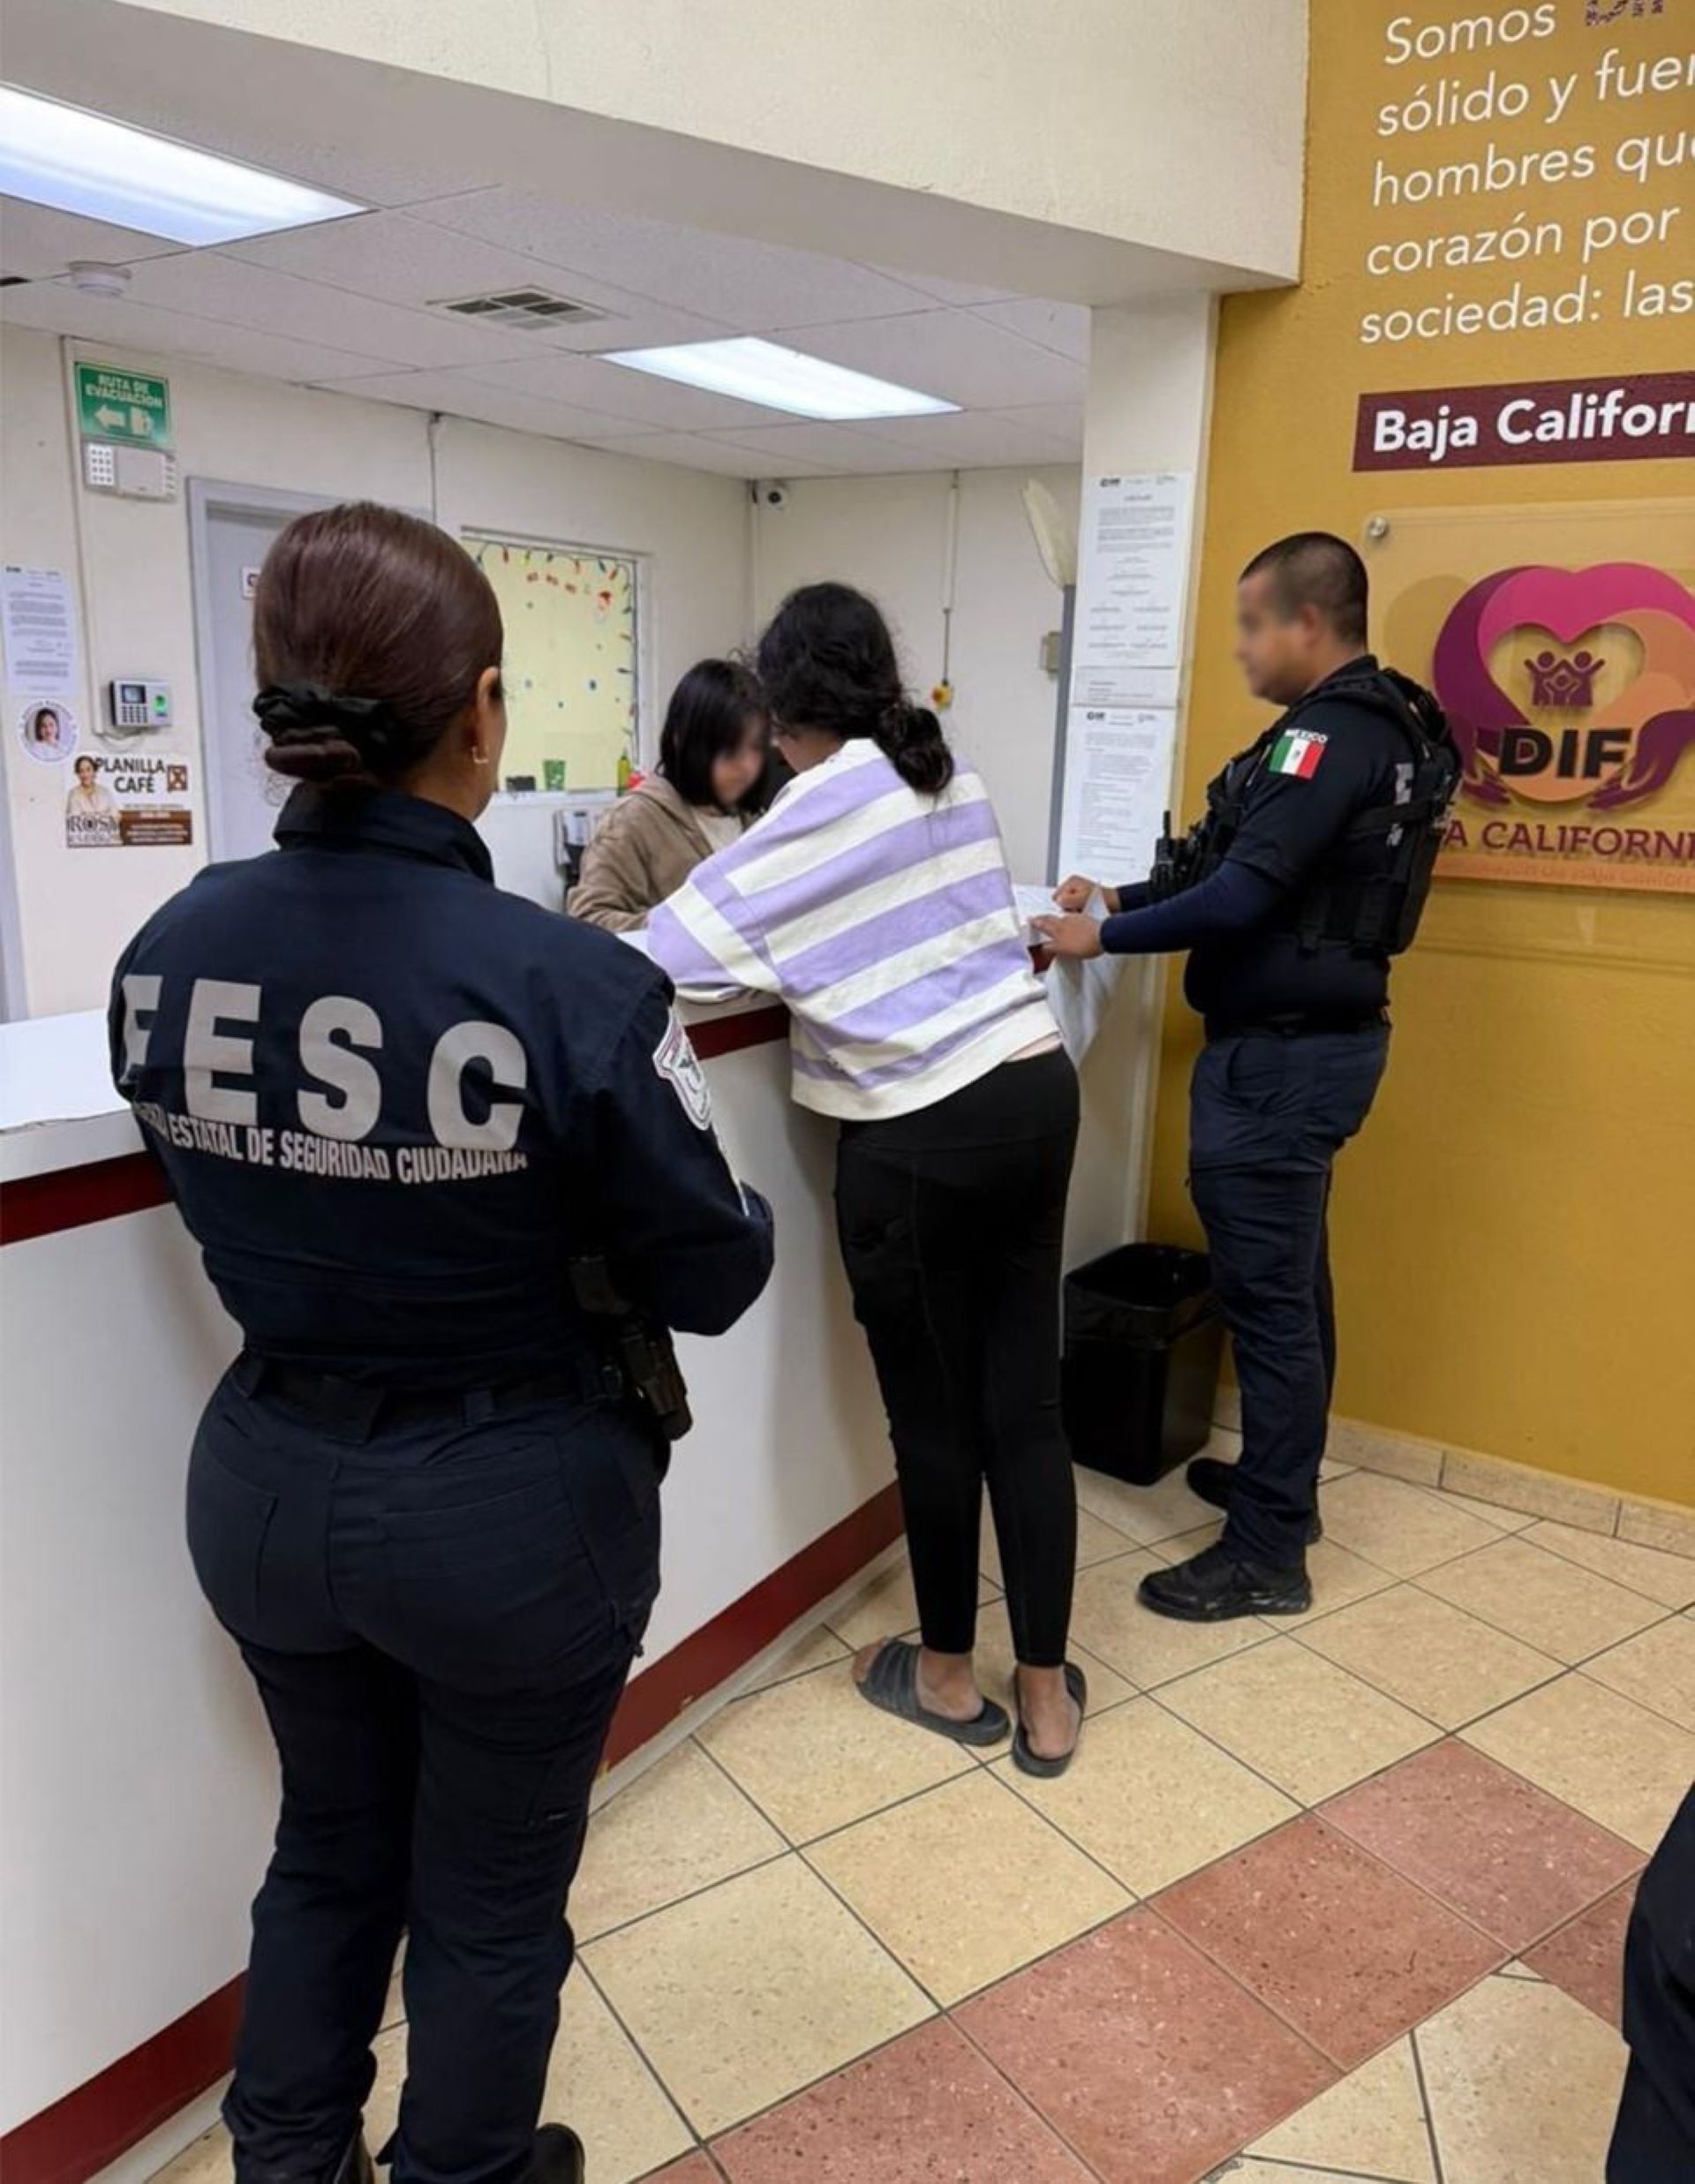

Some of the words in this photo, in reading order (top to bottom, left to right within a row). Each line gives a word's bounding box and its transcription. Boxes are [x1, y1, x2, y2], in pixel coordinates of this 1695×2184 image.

[1384, 4, 1556, 64] Somos
[1377, 70, 1530, 137] sólido
[1544, 73, 1578, 124] y
[1373, 143, 1595, 207] hombres
[1616, 132, 1695, 184] qu
[1367, 211, 1563, 275] corazón
[1582, 206, 1681, 264] por
[1360, 275, 1603, 343] sociedad:
[1623, 268, 1695, 318] las
[1373, 404, 1478, 463] Baja
[94, 757, 165, 774] PLANILLA
[114, 772, 155, 794] CAFÉ
[1500, 727, 1633, 779] DIF
[118, 973, 528, 1152] FESC
[168, 1113, 244, 1161] ESTATAL
[246, 1126, 275, 1166] DE
[280, 1129, 392, 1181] SEGURIDAD
[396, 1147, 528, 1185] CIUDADANA
